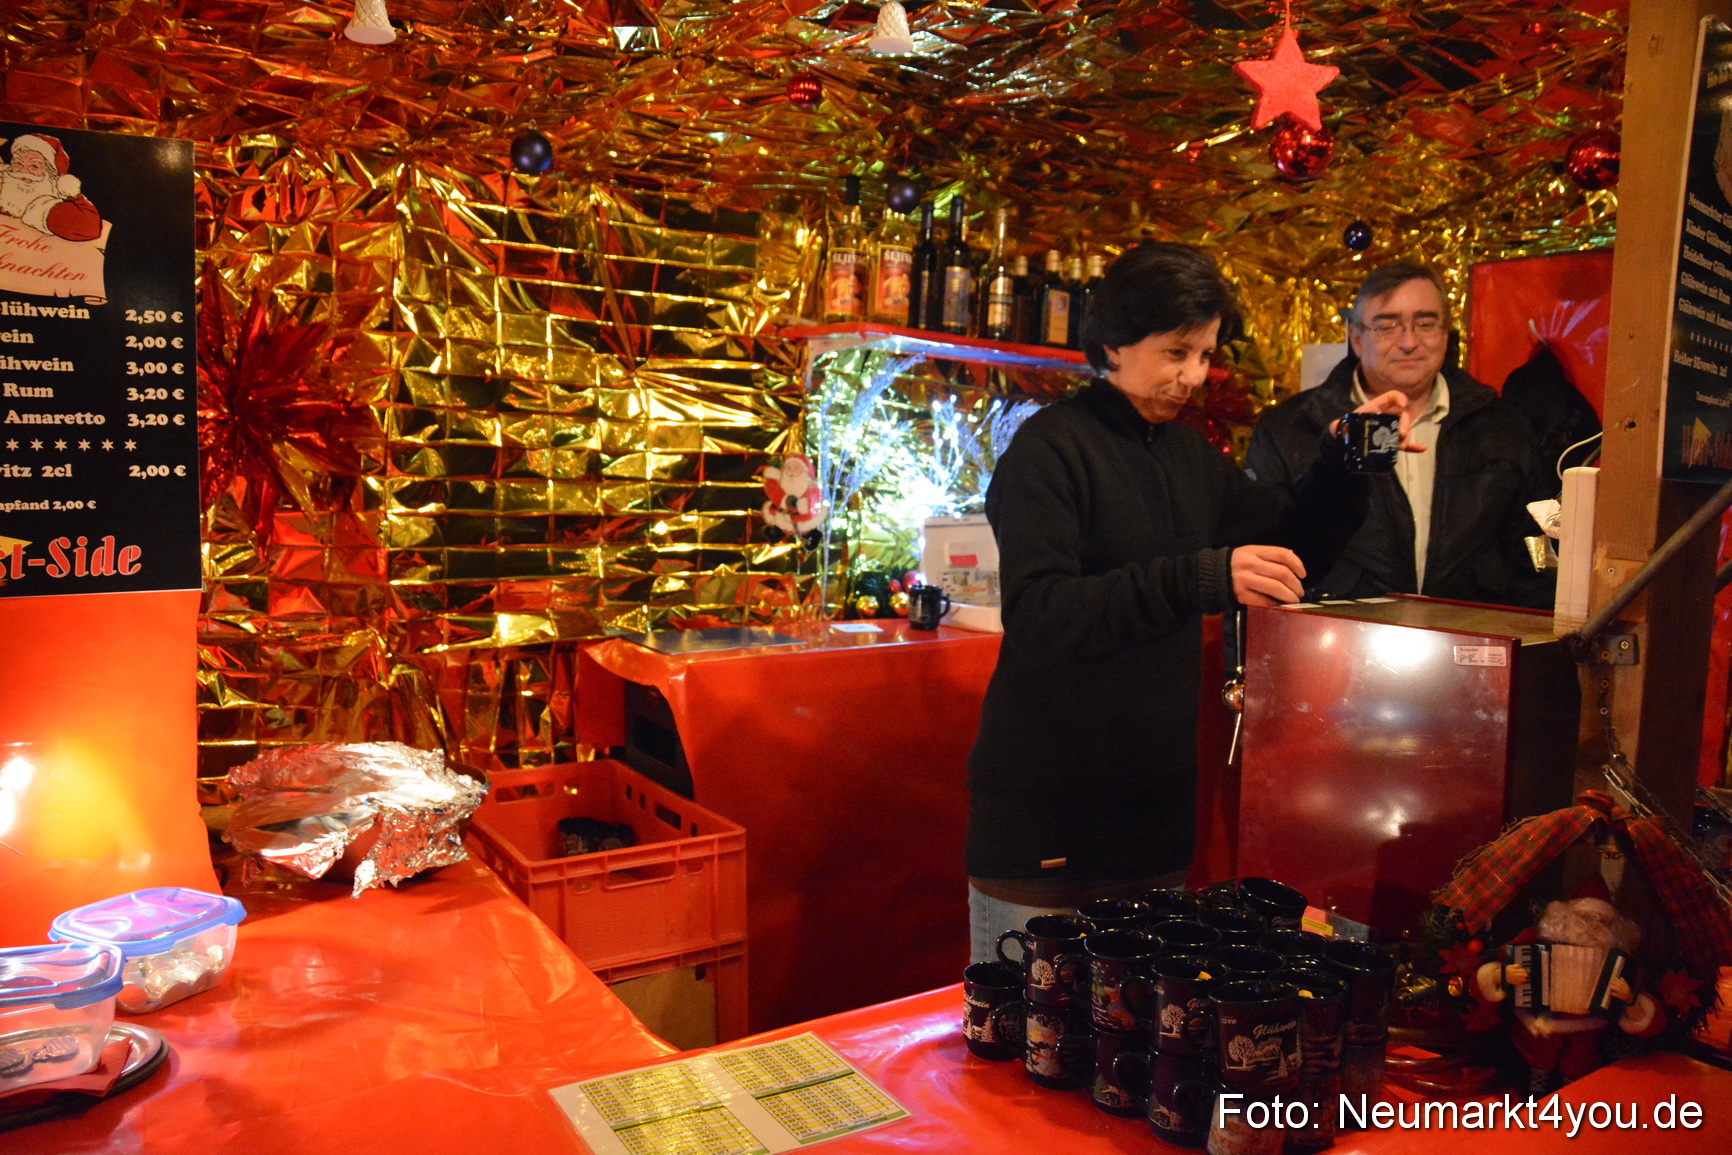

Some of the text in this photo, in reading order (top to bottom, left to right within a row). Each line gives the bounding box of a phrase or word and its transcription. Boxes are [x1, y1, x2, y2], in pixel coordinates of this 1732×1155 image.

[0, 301, 184, 324] lühwein 2,50 €
[125, 335, 167, 350] 2,00
[171, 337, 184, 349] €
[126, 361, 168, 376] 3,00
[171, 362, 184, 375] €
[3, 382, 185, 402] Rum 3,20 €
[4, 409, 186, 428] Amaretto 3,20 €
[41, 463, 72, 478] 2cl
[129, 465, 170, 479] 2,00
[174, 465, 187, 477] €
[52, 500, 84, 511] 2,00
[86, 500, 97, 509] €
